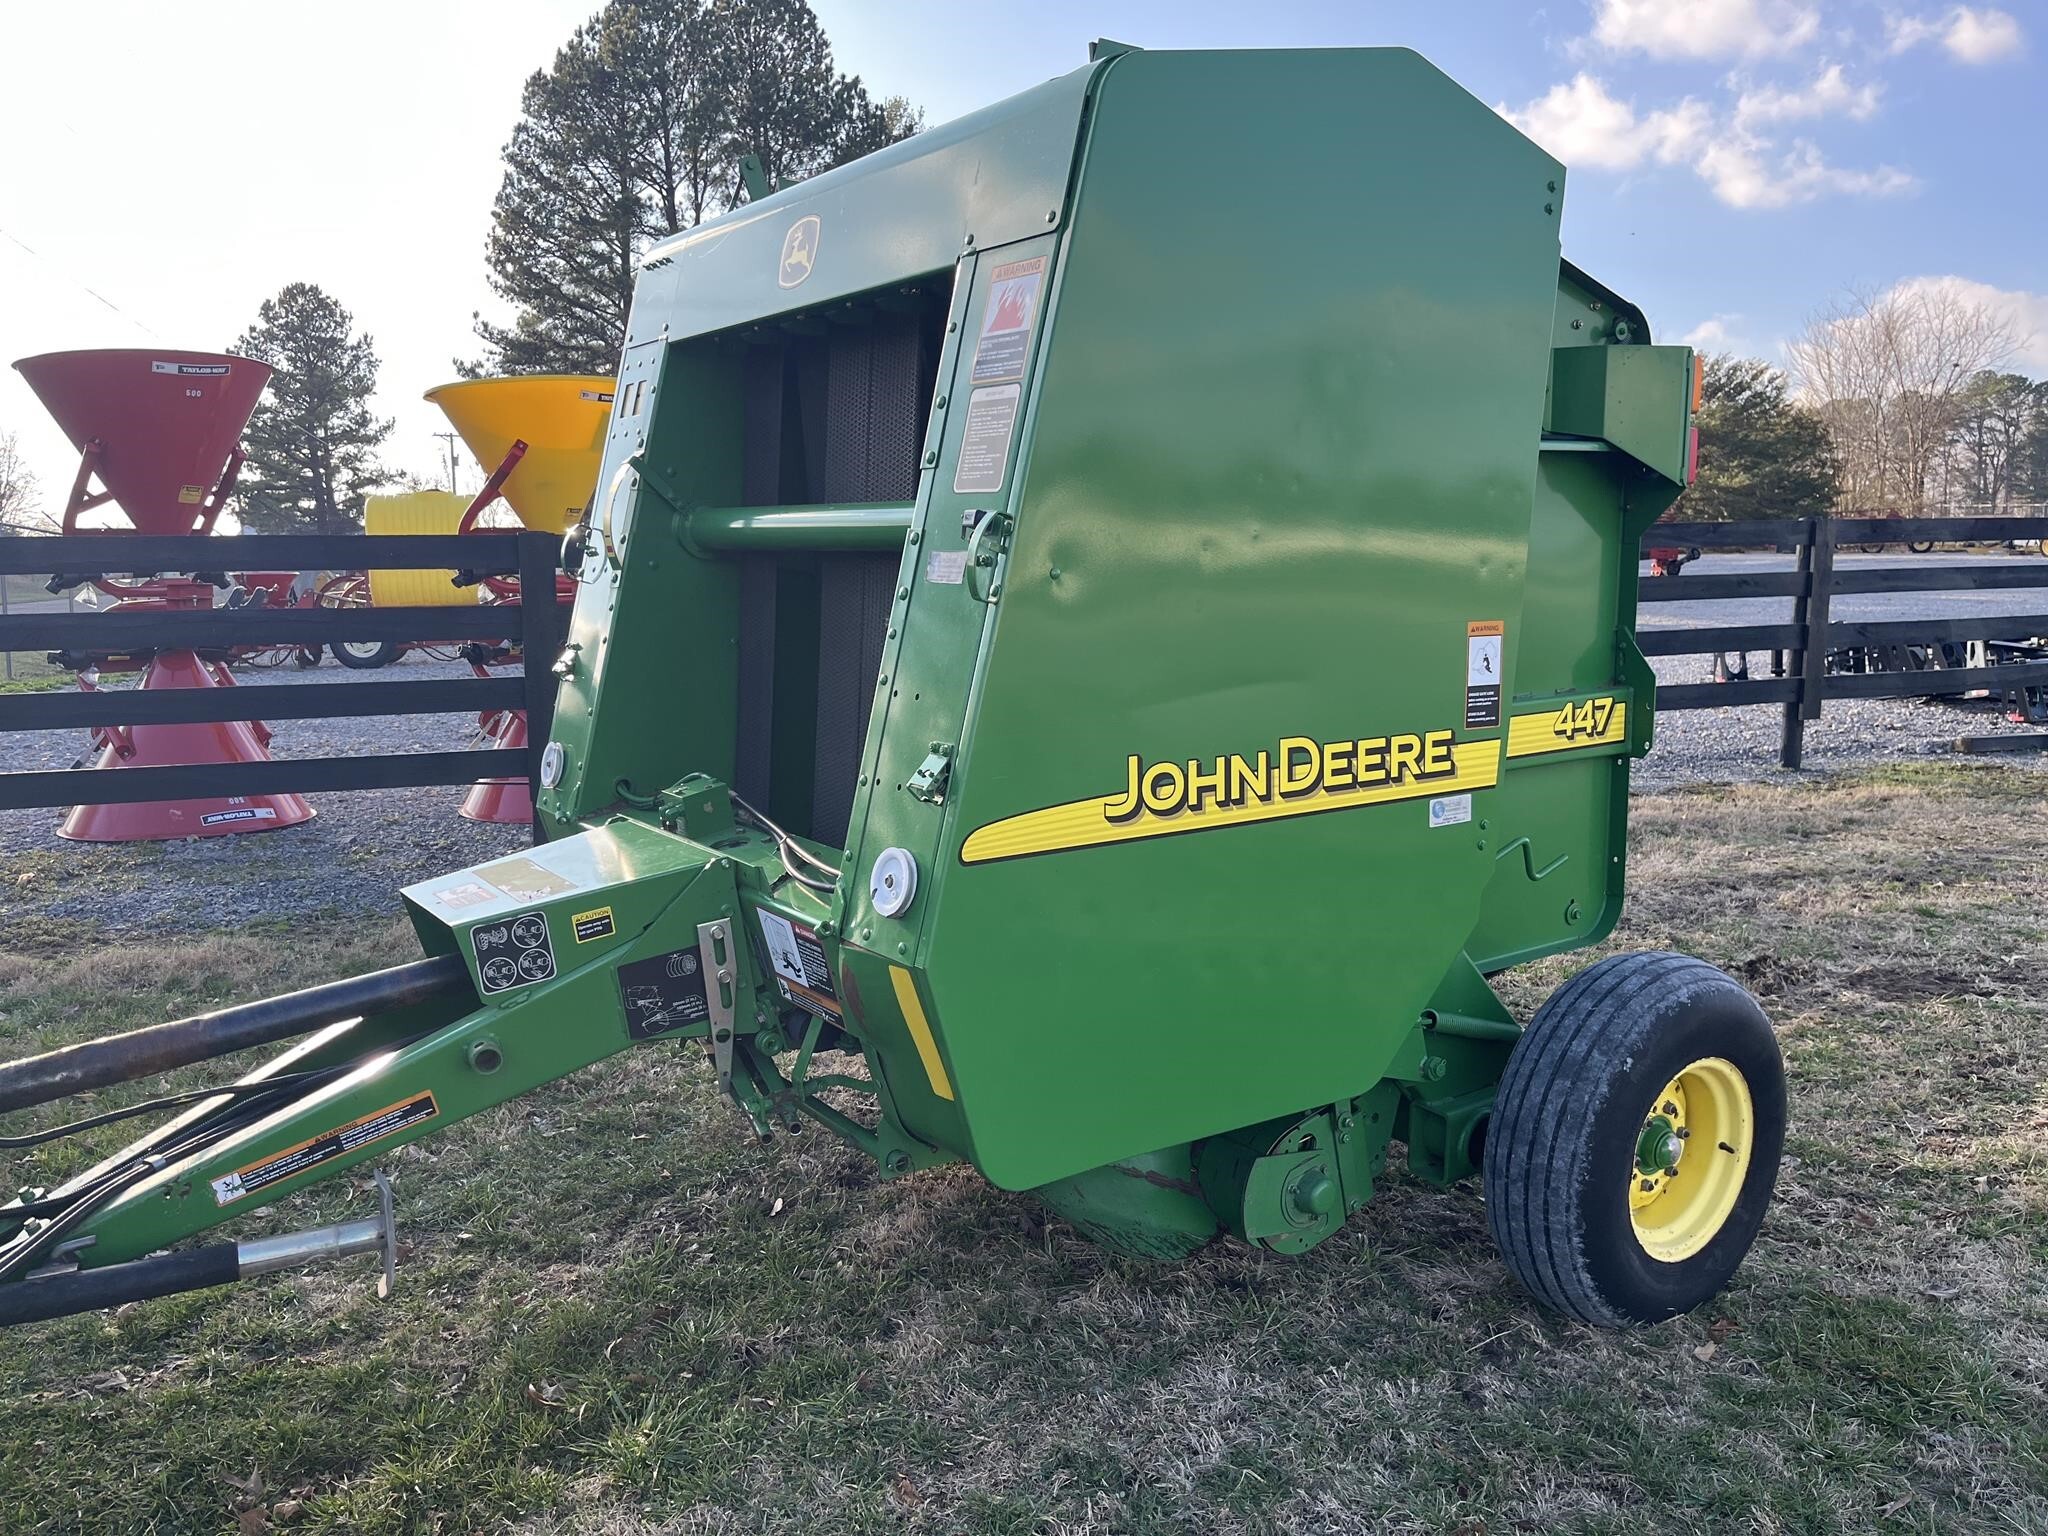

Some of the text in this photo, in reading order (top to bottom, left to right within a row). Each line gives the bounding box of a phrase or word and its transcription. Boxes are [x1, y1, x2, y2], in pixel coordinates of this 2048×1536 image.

[1554, 696, 1614, 740] 447
[1104, 729, 1456, 823] JOHN DEERE
[580, 910, 609, 921] CAUTION
[320, 1121, 358, 1140] WARNING
